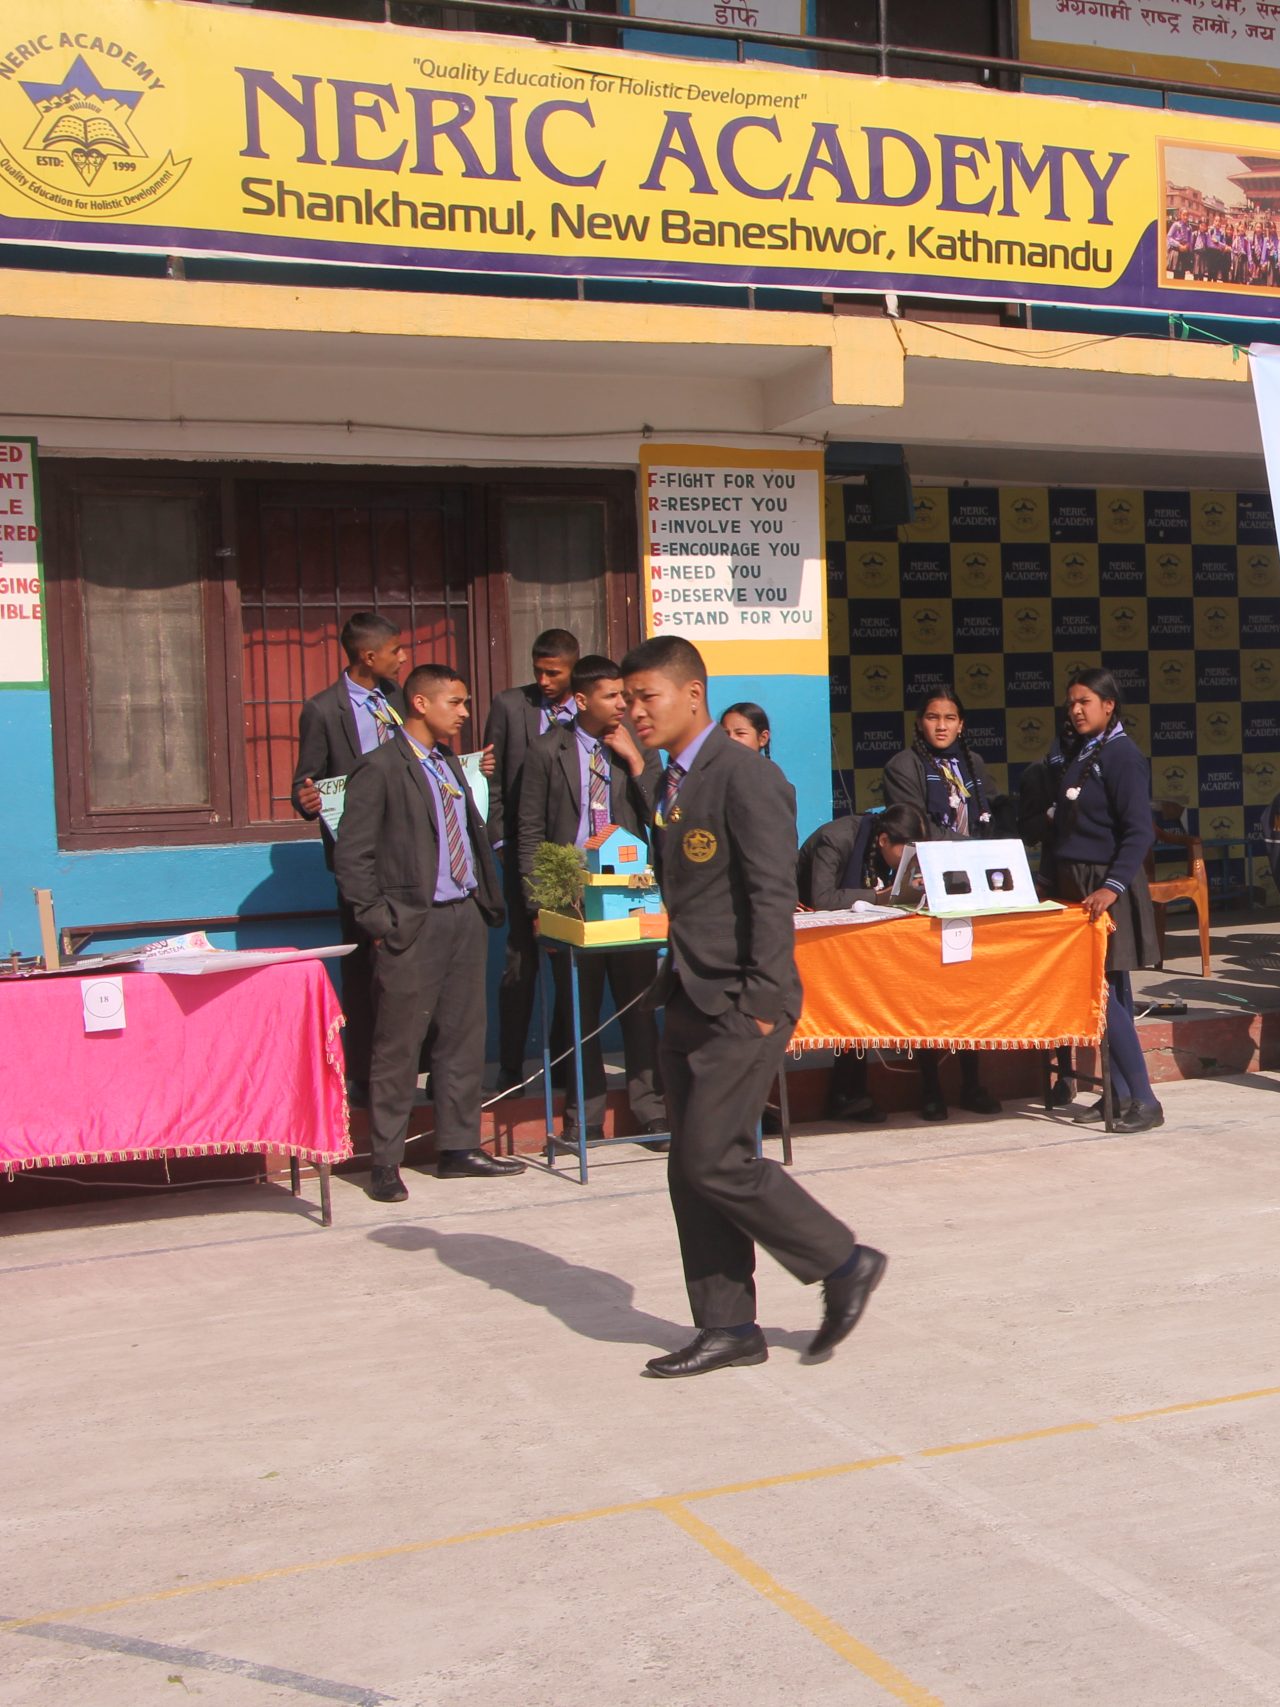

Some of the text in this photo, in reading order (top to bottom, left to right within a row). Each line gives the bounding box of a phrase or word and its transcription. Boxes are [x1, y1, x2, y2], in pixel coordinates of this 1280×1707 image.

[1140, 8, 1182, 33] राष्ट्र
[1192, 14, 1237, 39] हाम्रो,
[1245, 23, 1276, 41] जय
[0, 32, 166, 91] NERIC ACADEMY
[412, 57, 808, 109] "Quality Education for Holistic Development"
[234, 66, 1130, 227] NERIC ACADEMY
[36, 155, 65, 167] ESTD:
[112, 161, 137, 172] 1999
[0, 158, 173, 211] Quality Education for Holistic Development
[241, 176, 1115, 274] Shankhamul, New Baneshwor, Kathmandu
[724, 472, 755, 489] FOR
[763, 472, 796, 489] YOU
[752, 497, 788, 512] YOU
[959, 506, 989, 516] NERIC
[1059, 507, 1087, 516] NERIC
[1154, 508, 1181, 517] NERIC
[1245, 511, 1271, 519] NERIC
[952, 516, 997, 526] ACADEMY
[1052, 516, 1095, 526] ACADEMY
[1147, 518, 1189, 527] ACADEMY
[749, 519, 784, 534] YOU
[768, 542, 800, 557] YOU
[910, 561, 939, 571] NERIC
[1012, 561, 1041, 571] NERIC
[1109, 561, 1136, 570] NERIC
[1202, 562, 1228, 571] NERIC
[727, 565, 762, 580] YOU
[902, 571, 949, 581] ACADEMY
[1004, 571, 1049, 581] ACADEMY
[1102, 571, 1144, 580] ACADEMY
[1195, 572, 1235, 581] ACADEMY
[755, 587, 787, 603] YOU
[740, 610, 771, 627] FOR
[780, 610, 813, 627] YOU
[860, 618, 890, 627] NERIC
[963, 617, 992, 626] NERIC
[1063, 616, 1090, 624] NERIC
[1157, 615, 1184, 624] NERIC
[1248, 615, 1274, 624] NERIC
[852, 627, 899, 637] ACADEMY
[956, 626, 1000, 636] ACADEMY
[1055, 625, 1098, 634] ACADEMY
[1150, 624, 1192, 633] ACADEMY
[1241, 624, 1280, 633] ACADEMY
[1015, 671, 1043, 680] NERIC
[1205, 667, 1231, 676] NERIC
[913, 673, 943, 683] NERIC
[1198, 676, 1239, 686] ACADEMY
[1008, 680, 1051, 690] ACADEMY
[1160, 721, 1187, 730] NERIC
[1250, 718, 1276, 727] NERIC
[864, 731, 893, 740] NERIC
[967, 727, 996, 737] NERIC
[1153, 730, 1195, 740] ACADEMY
[856, 740, 902, 750] ACADEMY
[1207, 772, 1233, 781] NERIC
[1200, 781, 1241, 791] ACADEMY
[99, 996, 109, 1004] 18
